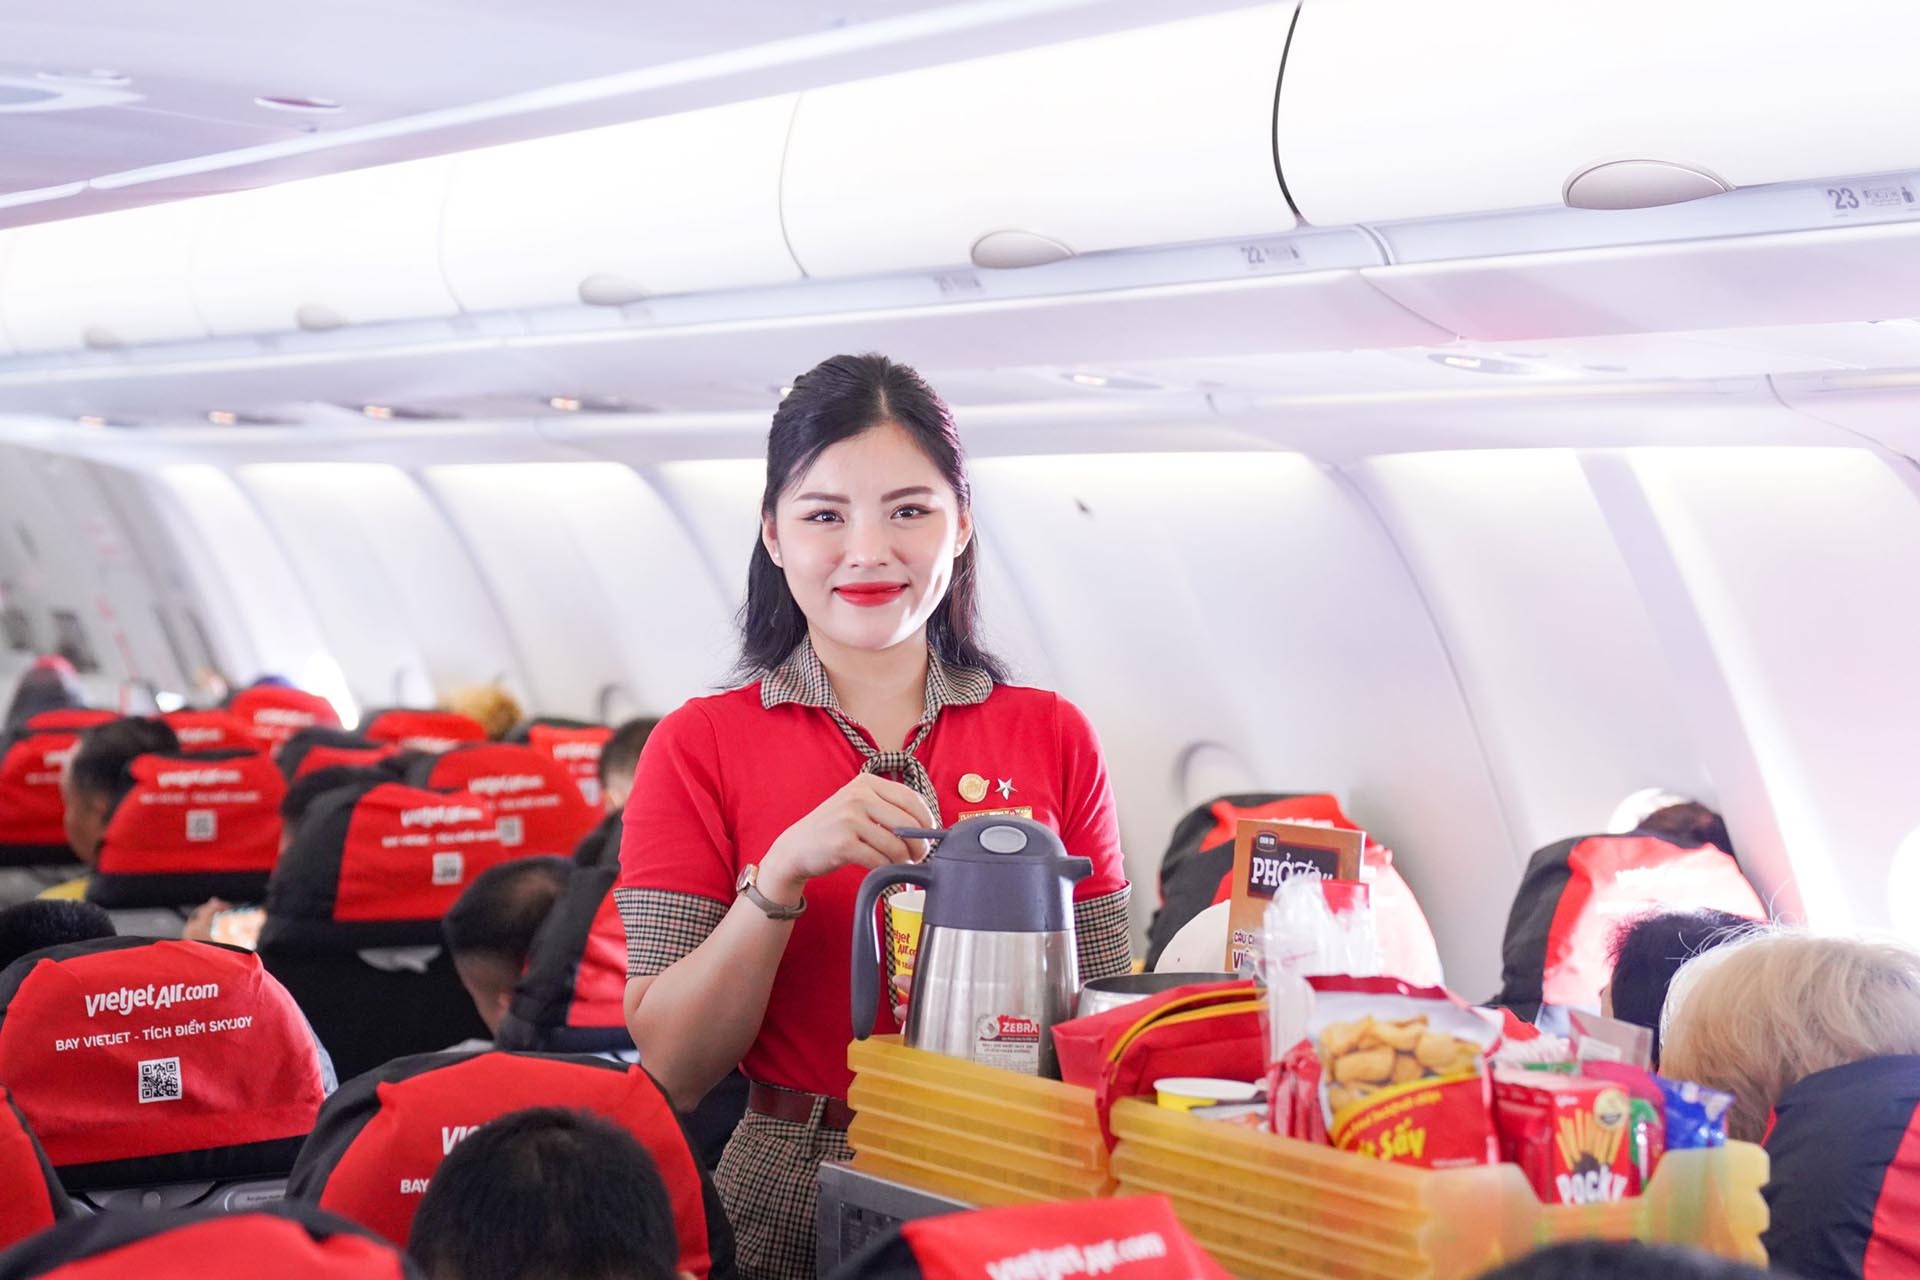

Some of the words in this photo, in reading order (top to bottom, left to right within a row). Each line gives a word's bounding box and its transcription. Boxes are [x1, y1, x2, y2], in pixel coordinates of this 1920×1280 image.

[1827, 187, 1860, 210] 23
[55, 1037, 80, 1052] BAY
[83, 1031, 131, 1048] VIETJET
[142, 1023, 172, 1041] TÍCH
[175, 1018, 206, 1037] ĐIỂM
[209, 1015, 253, 1033] SKYJOY
[1001, 1021, 1039, 1033] ZEBRA
[400, 1178, 430, 1194] BAY
